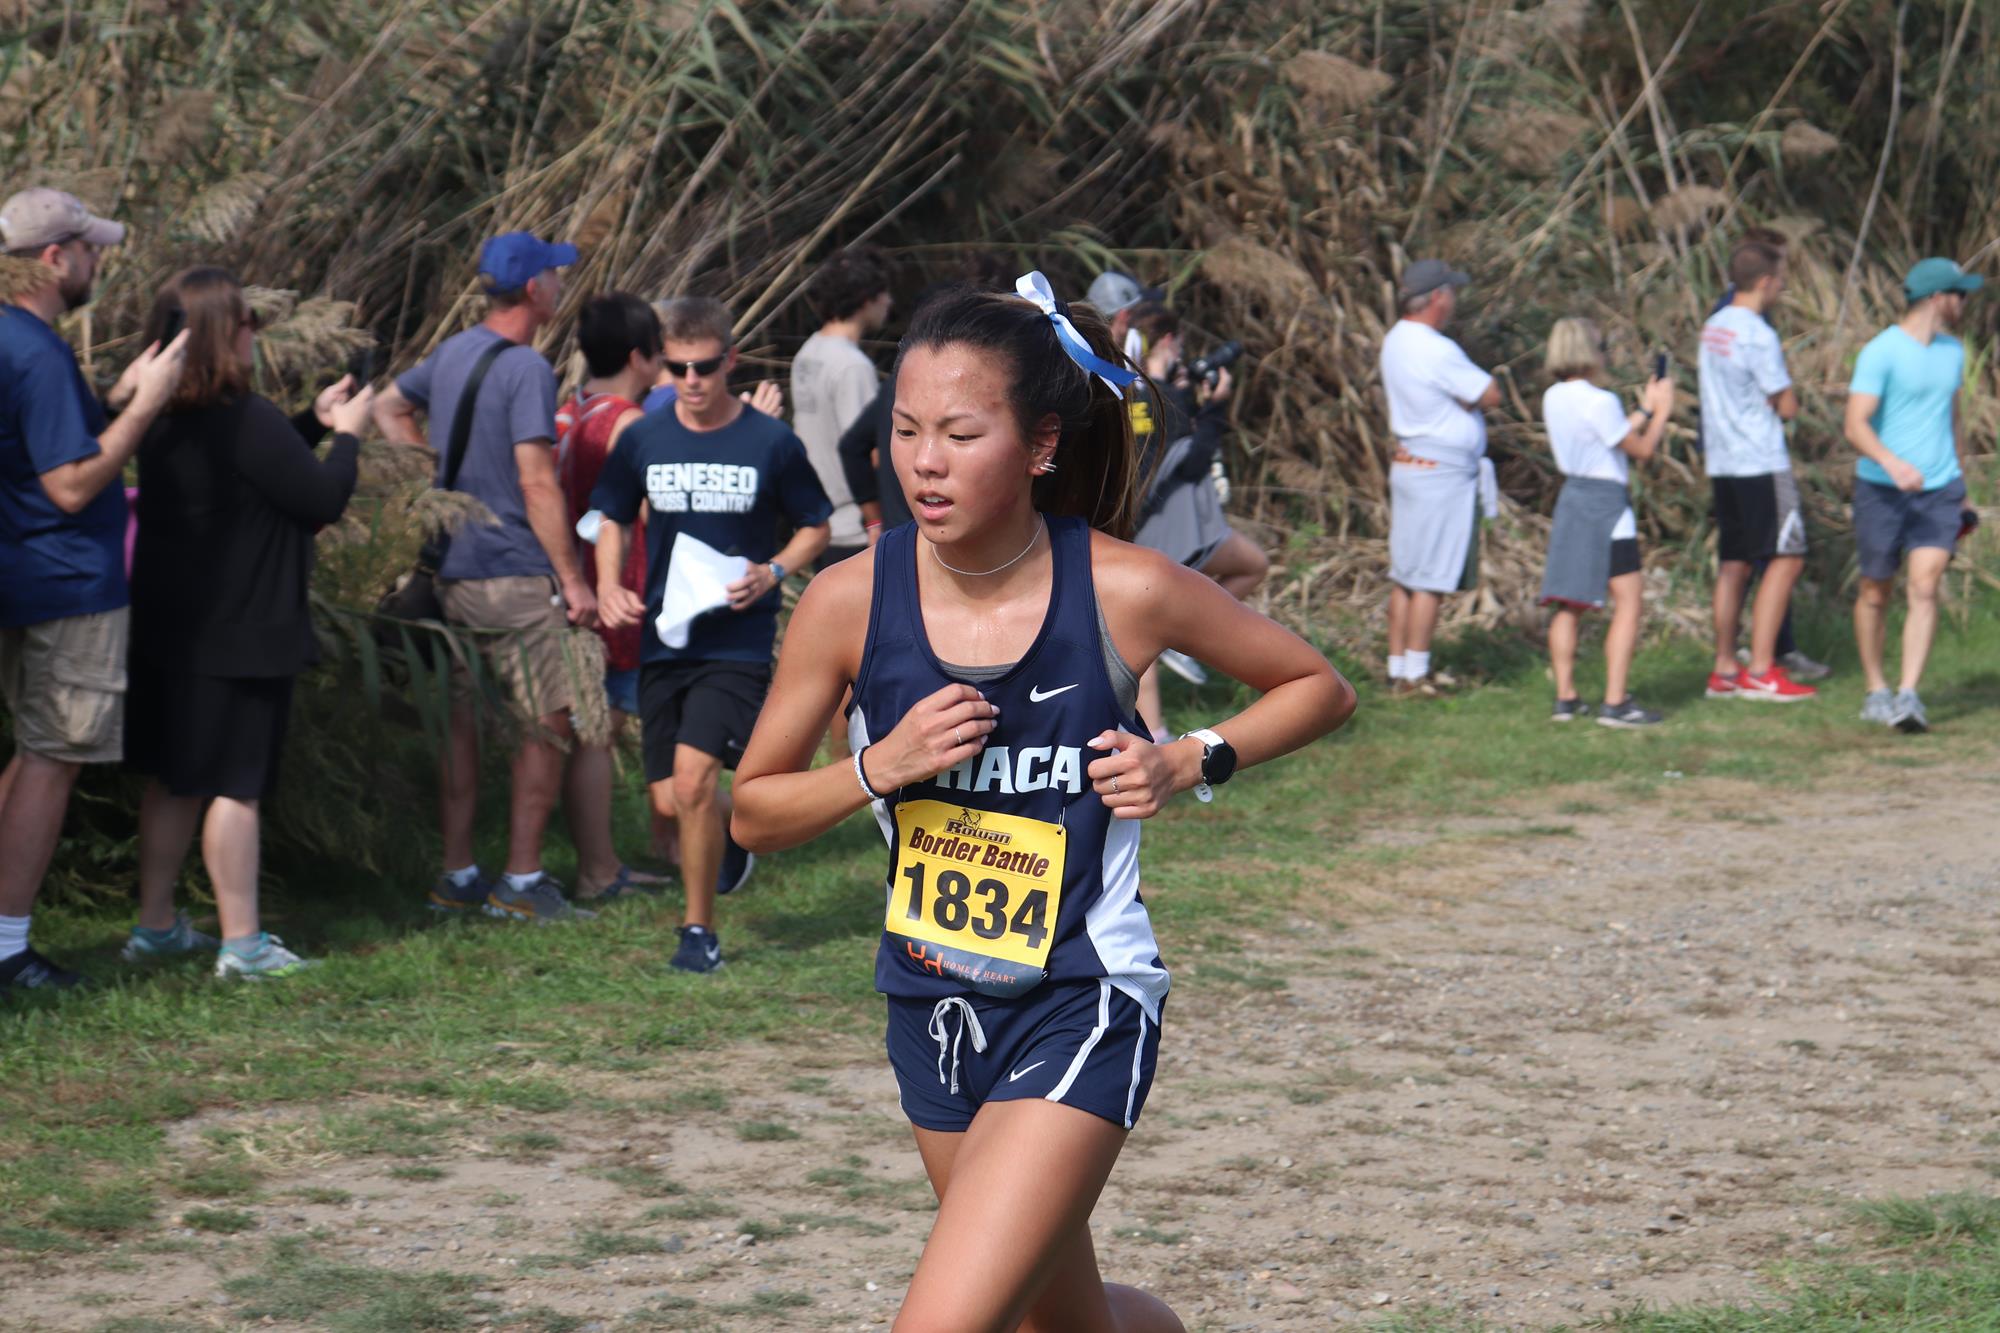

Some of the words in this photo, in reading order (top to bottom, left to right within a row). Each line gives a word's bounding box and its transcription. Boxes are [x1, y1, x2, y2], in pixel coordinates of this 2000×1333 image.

[646, 462, 758, 495] GENESEO
[691, 491, 756, 514] COUNTRY
[935, 745, 1082, 794] HACA
[909, 826, 982, 863] Border
[981, 844, 1050, 878] Battle
[903, 861, 1049, 949] 1834
[943, 960, 970, 974] HOME
[983, 970, 1016, 984] HEART
